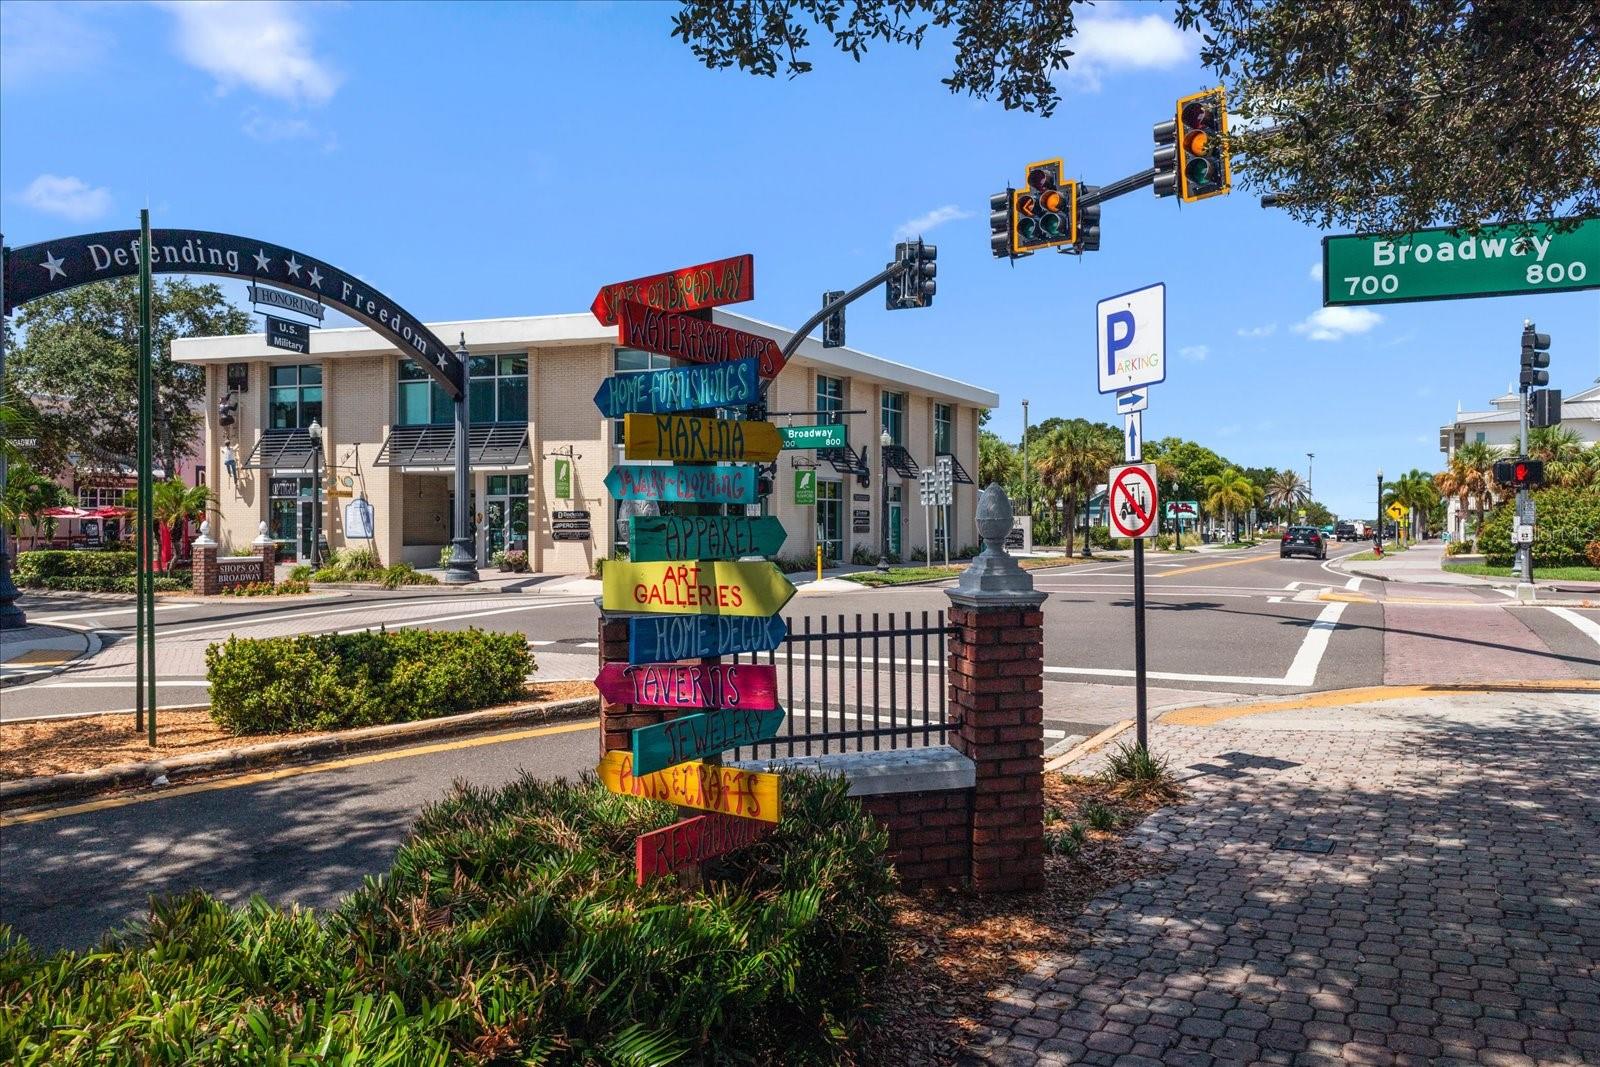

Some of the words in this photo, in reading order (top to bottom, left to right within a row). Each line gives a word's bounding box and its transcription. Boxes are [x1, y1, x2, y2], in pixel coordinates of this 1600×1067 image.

[1374, 234, 1553, 266] Broadway
[1344, 274, 1399, 295] 700
[1526, 261, 1587, 284] 800
[87, 238, 239, 272] Defending
[341, 280, 427, 354] Freedom
[262, 289, 319, 315] HONORING
[280, 323, 298, 335] U.S.
[273, 336, 304, 352] Military
[608, 374, 648, 416] HOME
[782, 440, 796, 448] 00
[825, 438, 841, 446] 800
[788, 428, 833, 438] Broadway
[665, 516, 760, 562] APPAREL
[218, 574, 262, 583] BROADWAY
[219, 564, 246, 573] SHOPS
[248, 563, 261, 572] ON
[662, 564, 701, 586] ART
[634, 583, 743, 608] GALLERIES
[655, 615, 710, 661] HOME
[718, 615, 775, 654] DECOR
